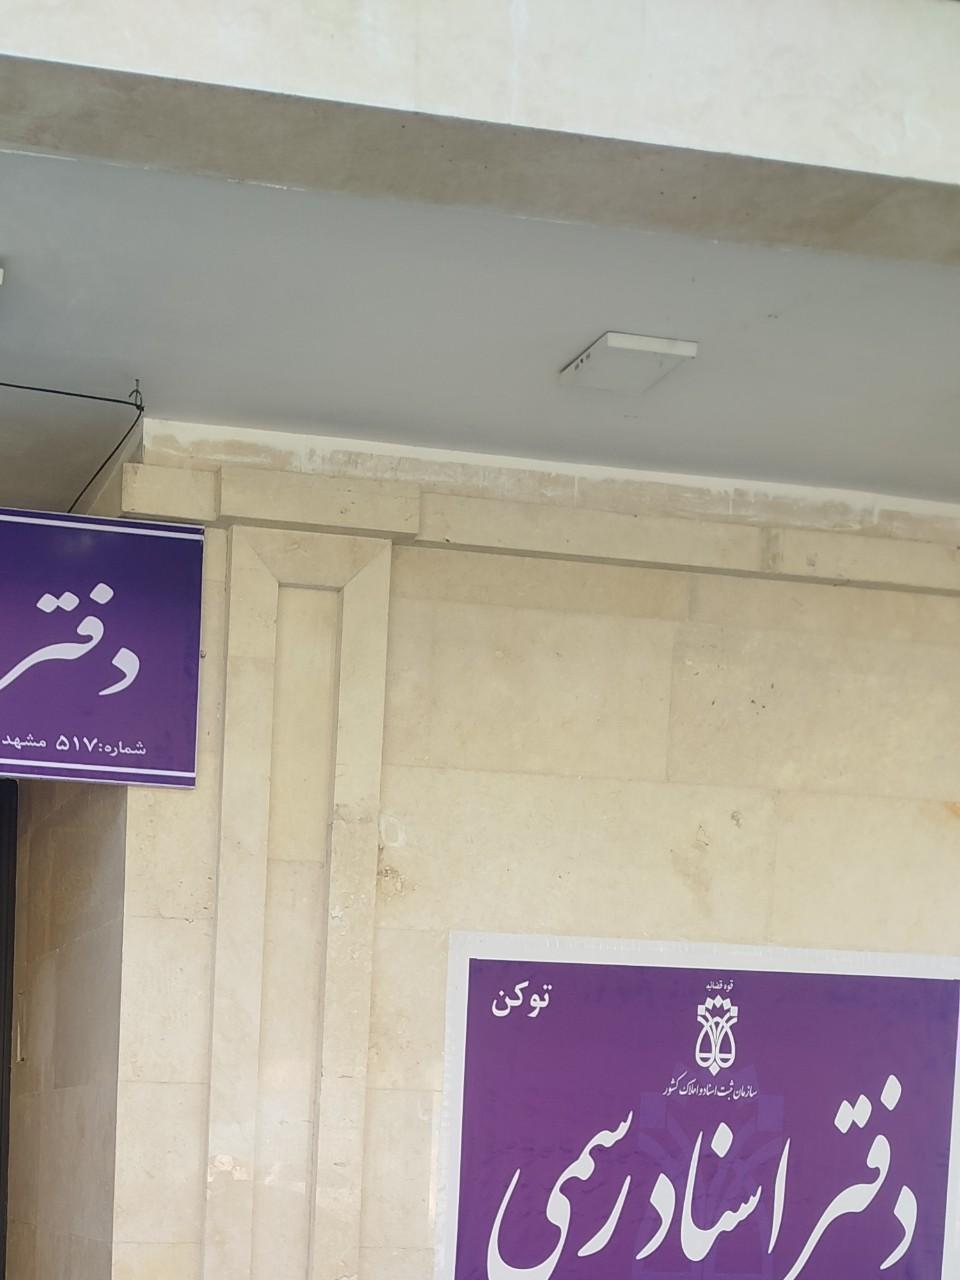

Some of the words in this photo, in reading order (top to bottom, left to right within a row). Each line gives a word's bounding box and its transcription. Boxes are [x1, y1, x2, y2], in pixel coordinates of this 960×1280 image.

[1, 732, 47, 750] مشهد
[491, 980, 553, 1018] توکن
[661, 1071, 688, 1097] کشور
[679, 1078, 699, 1096] املاک
[717, 1079, 734, 1101] ثبت
[732, 1085, 758, 1100] سازمان
[635, 1121, 792, 1263] اسناد
